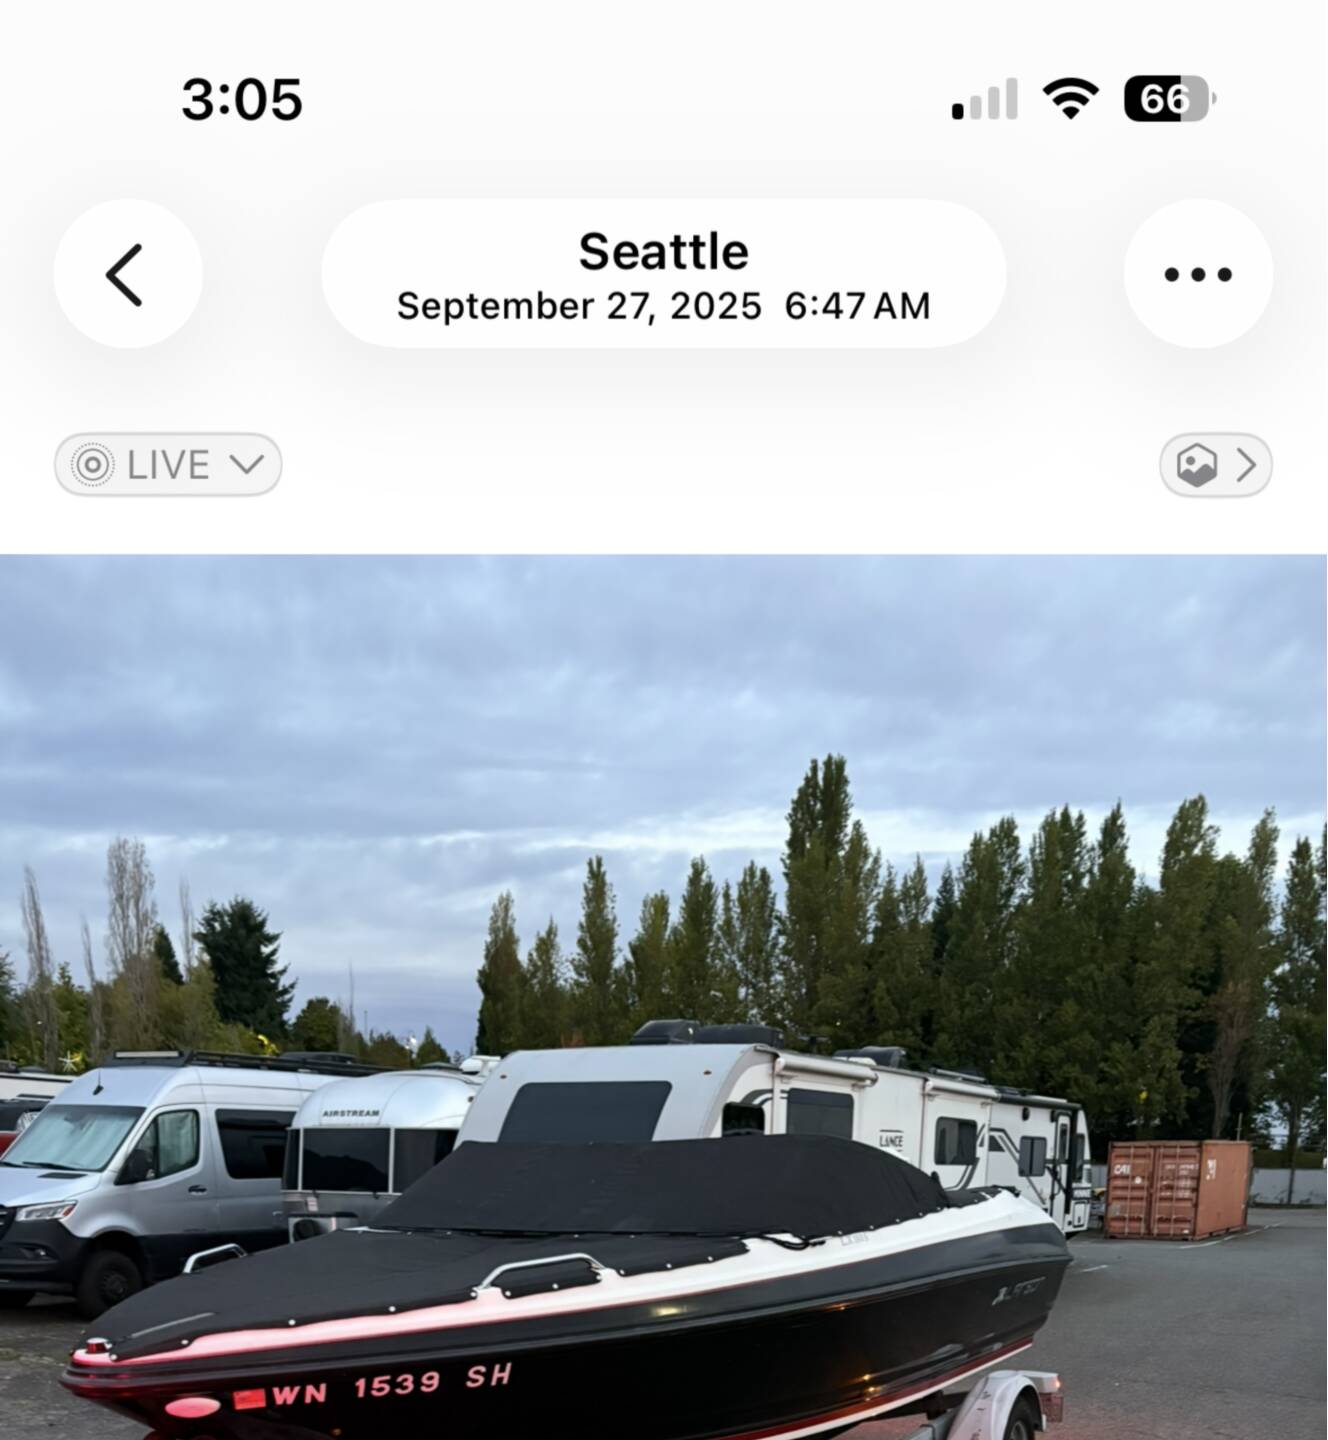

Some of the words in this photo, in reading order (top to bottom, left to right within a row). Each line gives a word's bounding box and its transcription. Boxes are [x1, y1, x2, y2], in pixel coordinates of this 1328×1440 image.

[181, 76, 303, 122] 3:05
[1140, 83, 1190, 114] 66
[579, 230, 749, 272] Seattle
[397, 289, 596, 327] September
[607, 290, 656, 327] 27,
[671, 290, 762, 321] 2025
[785, 290, 866, 321] 6:47
[873, 291, 930, 321] AM
[128, 449, 209, 480] LIVE
[322, 1109, 380, 1118] AIRSTREAM
[272, 1382, 327, 1406] WN
[355, 1371, 440, 1398] 1539
[465, 1362, 512, 1388] SH
